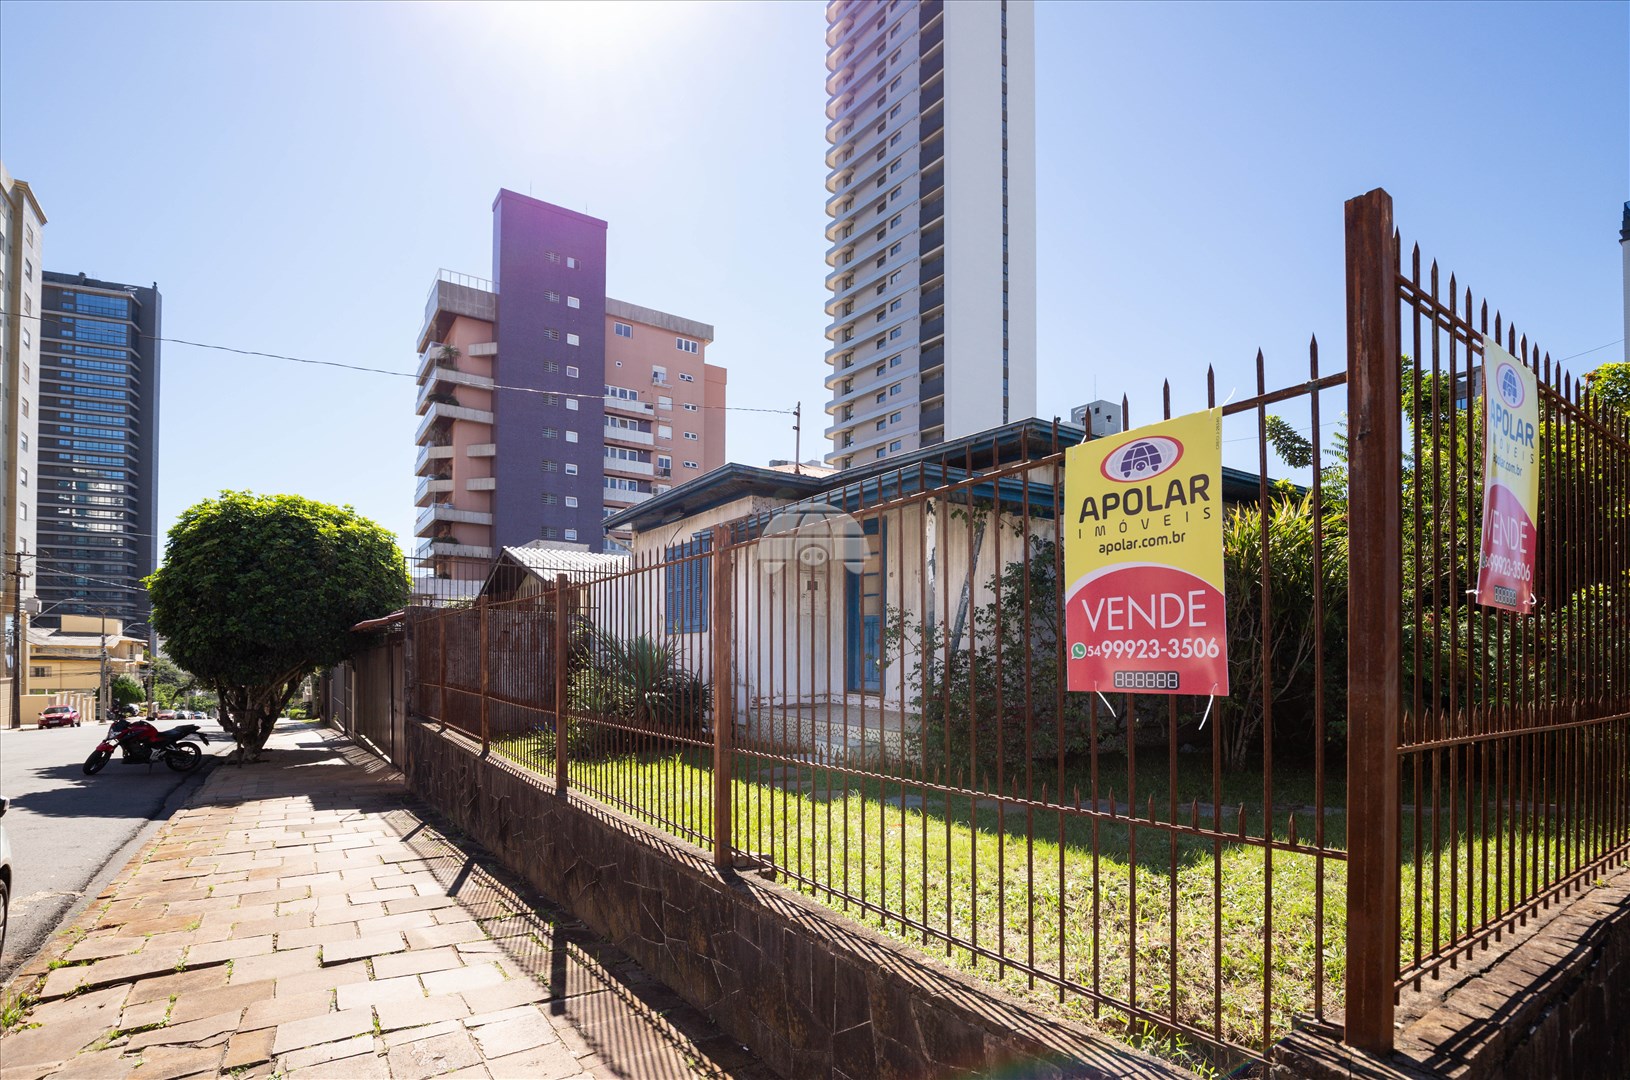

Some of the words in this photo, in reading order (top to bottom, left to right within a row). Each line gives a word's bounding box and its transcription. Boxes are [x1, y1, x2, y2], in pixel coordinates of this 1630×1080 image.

[1490, 398, 1534, 449] APOLAR
[1079, 473, 1210, 523] APOLAR
[1078, 507, 1211, 539] IMÓVEIS
[1099, 531, 1186, 555] apolar.com.br
[1486, 508, 1528, 554] VENDE
[1081, 589, 1207, 632] VENDE
